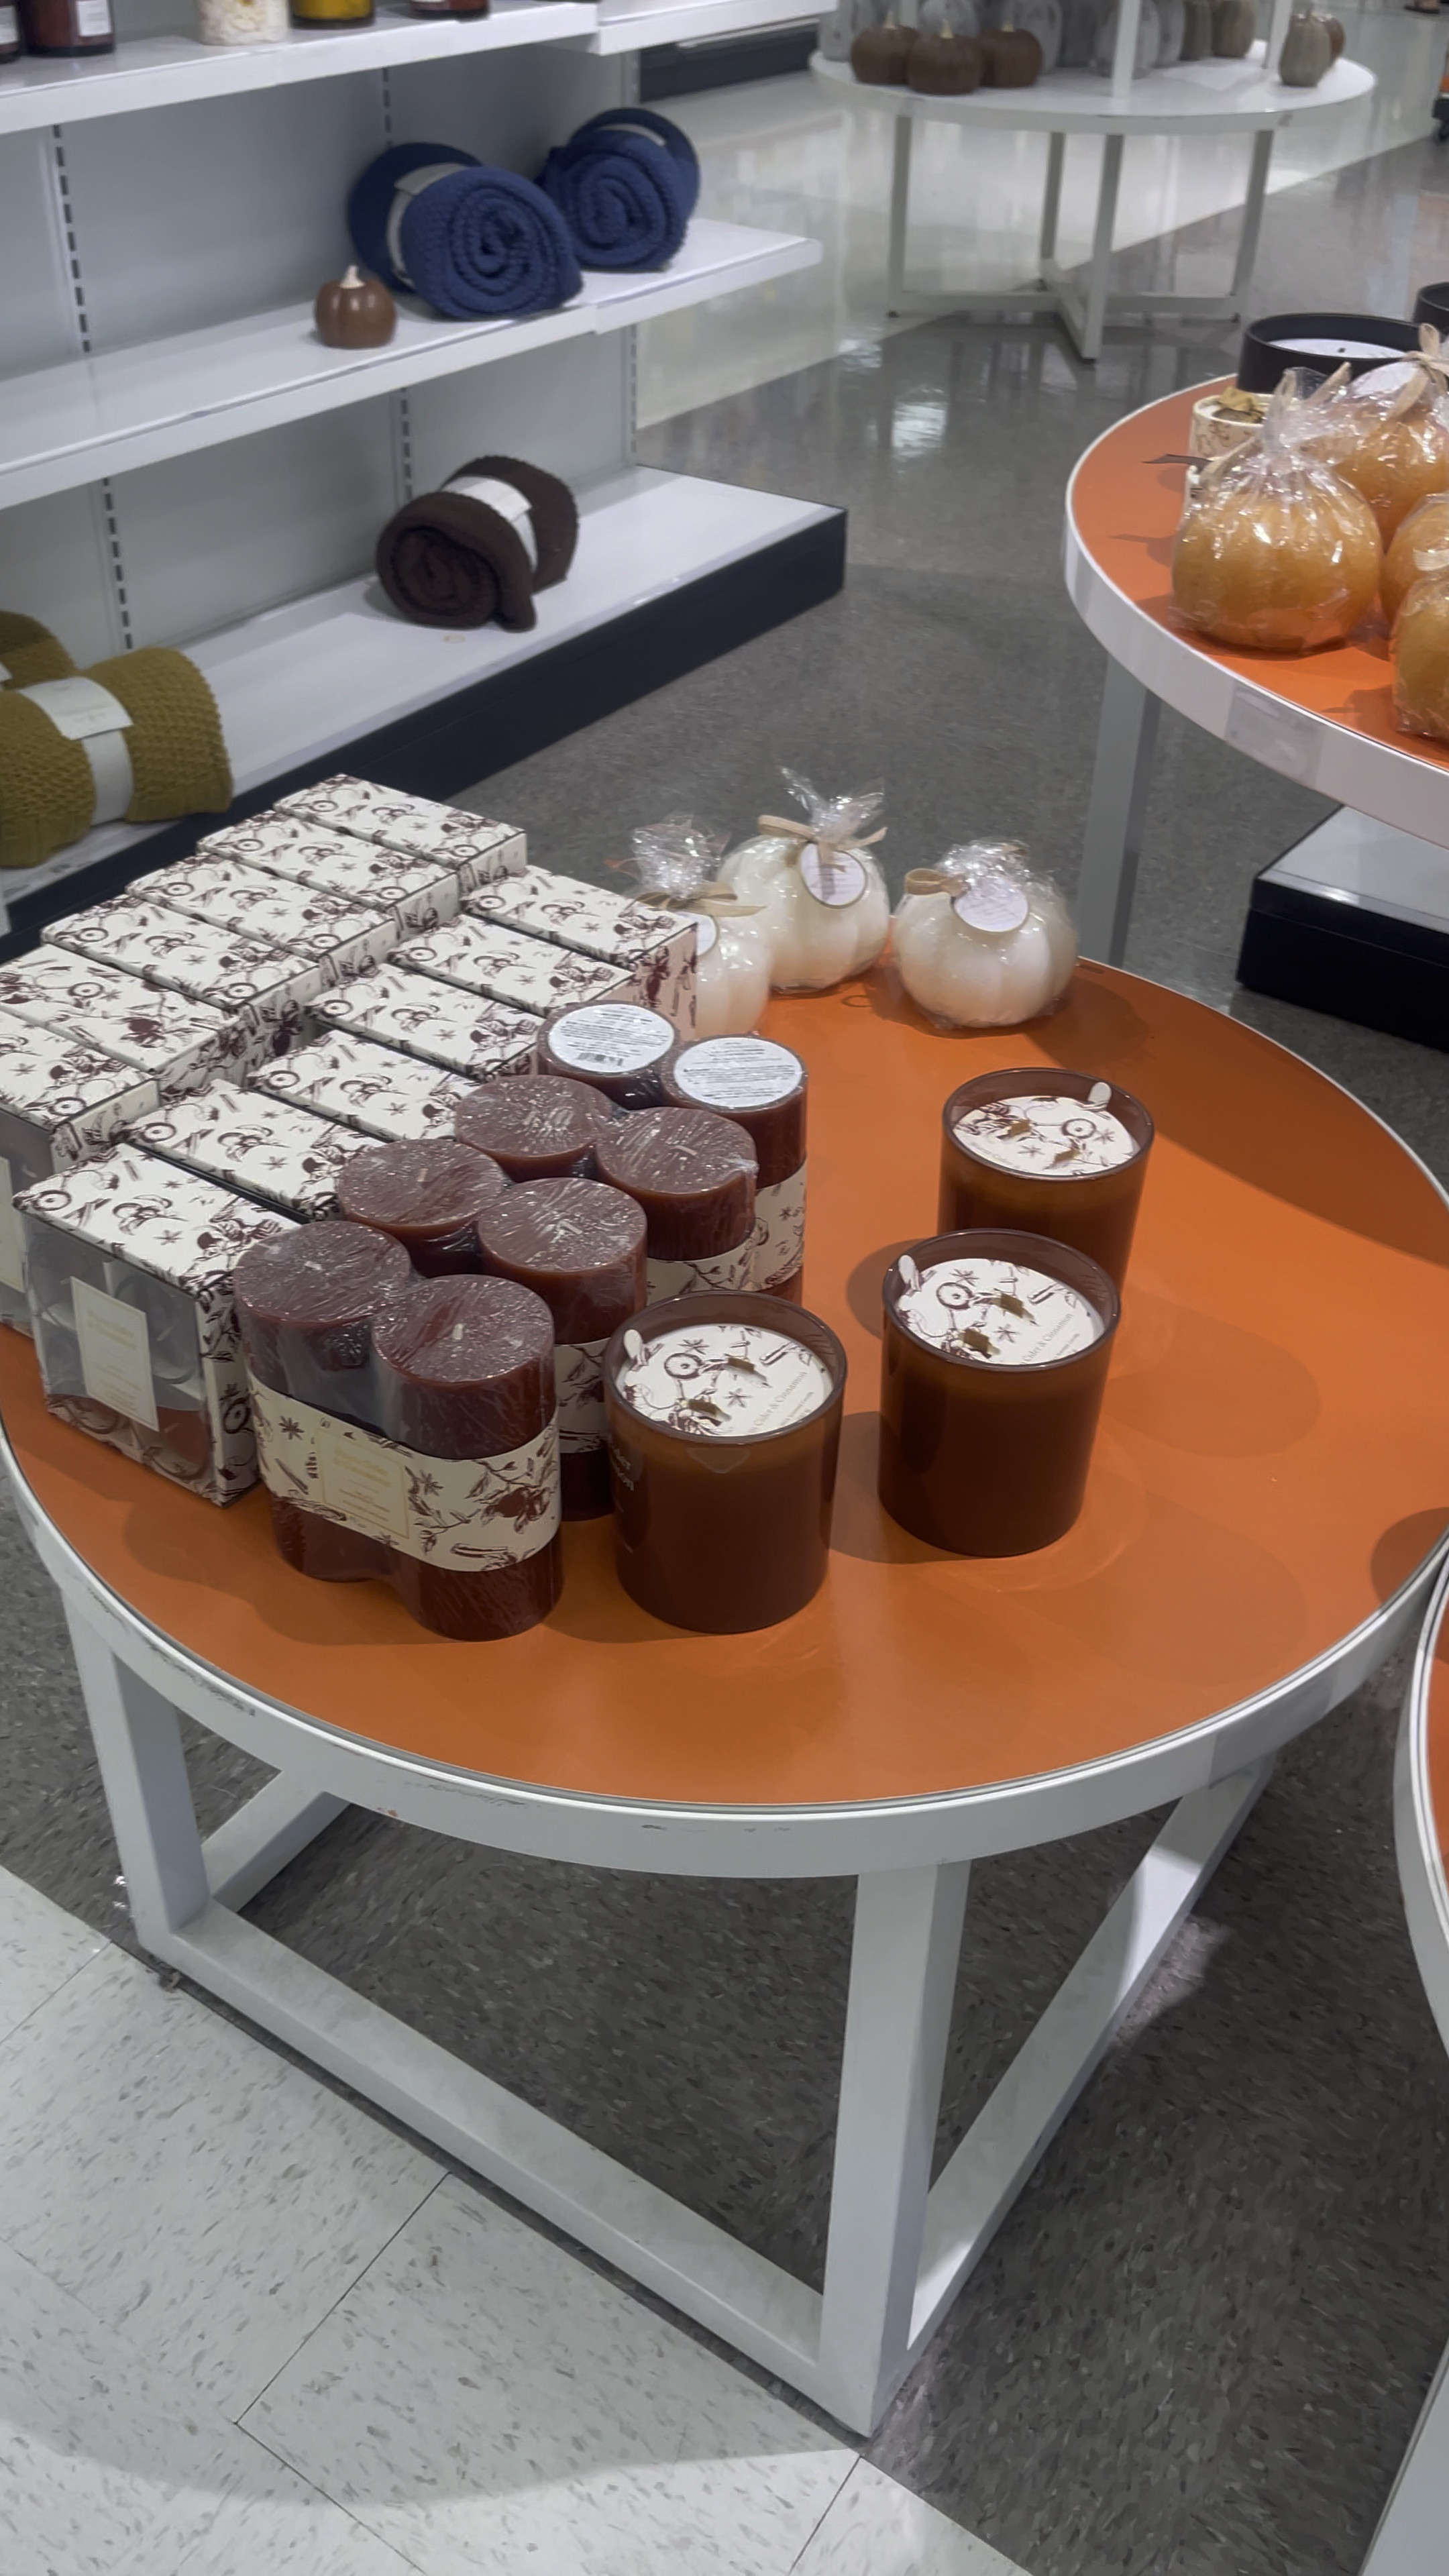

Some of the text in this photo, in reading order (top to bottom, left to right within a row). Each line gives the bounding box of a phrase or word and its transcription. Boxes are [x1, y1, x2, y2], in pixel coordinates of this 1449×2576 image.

[1022, 1348, 1042, 1362] Cider
[1042, 1313, 1075, 1342] Cinnamon
[753, 1409, 773, 1426] Cider
[775, 1371, 808, 1403] Cinnamon
